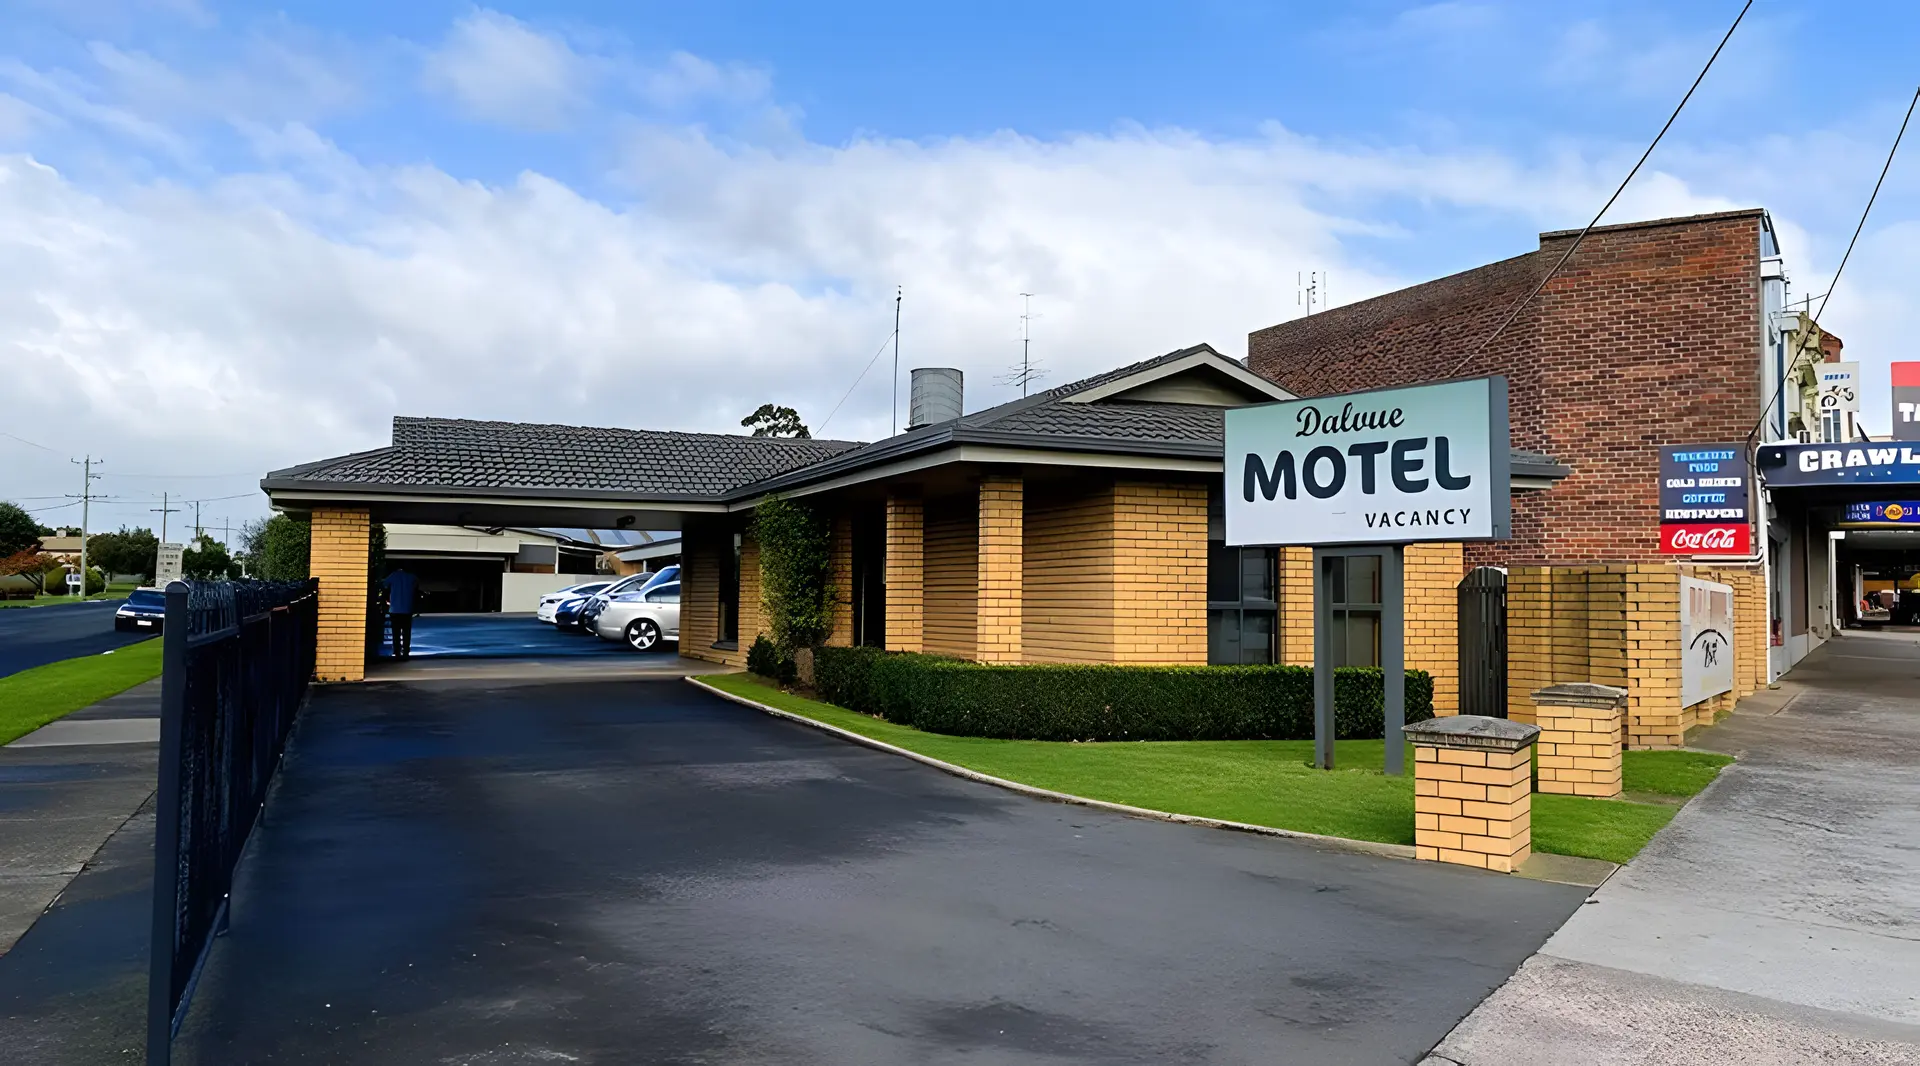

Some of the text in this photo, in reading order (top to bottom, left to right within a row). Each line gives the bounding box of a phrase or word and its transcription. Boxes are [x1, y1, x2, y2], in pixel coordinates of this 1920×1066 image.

[1295, 401, 1405, 437] Dalvue
[1243, 436, 1471, 502] MOTEL
[1365, 508, 1471, 528] VACANCY
